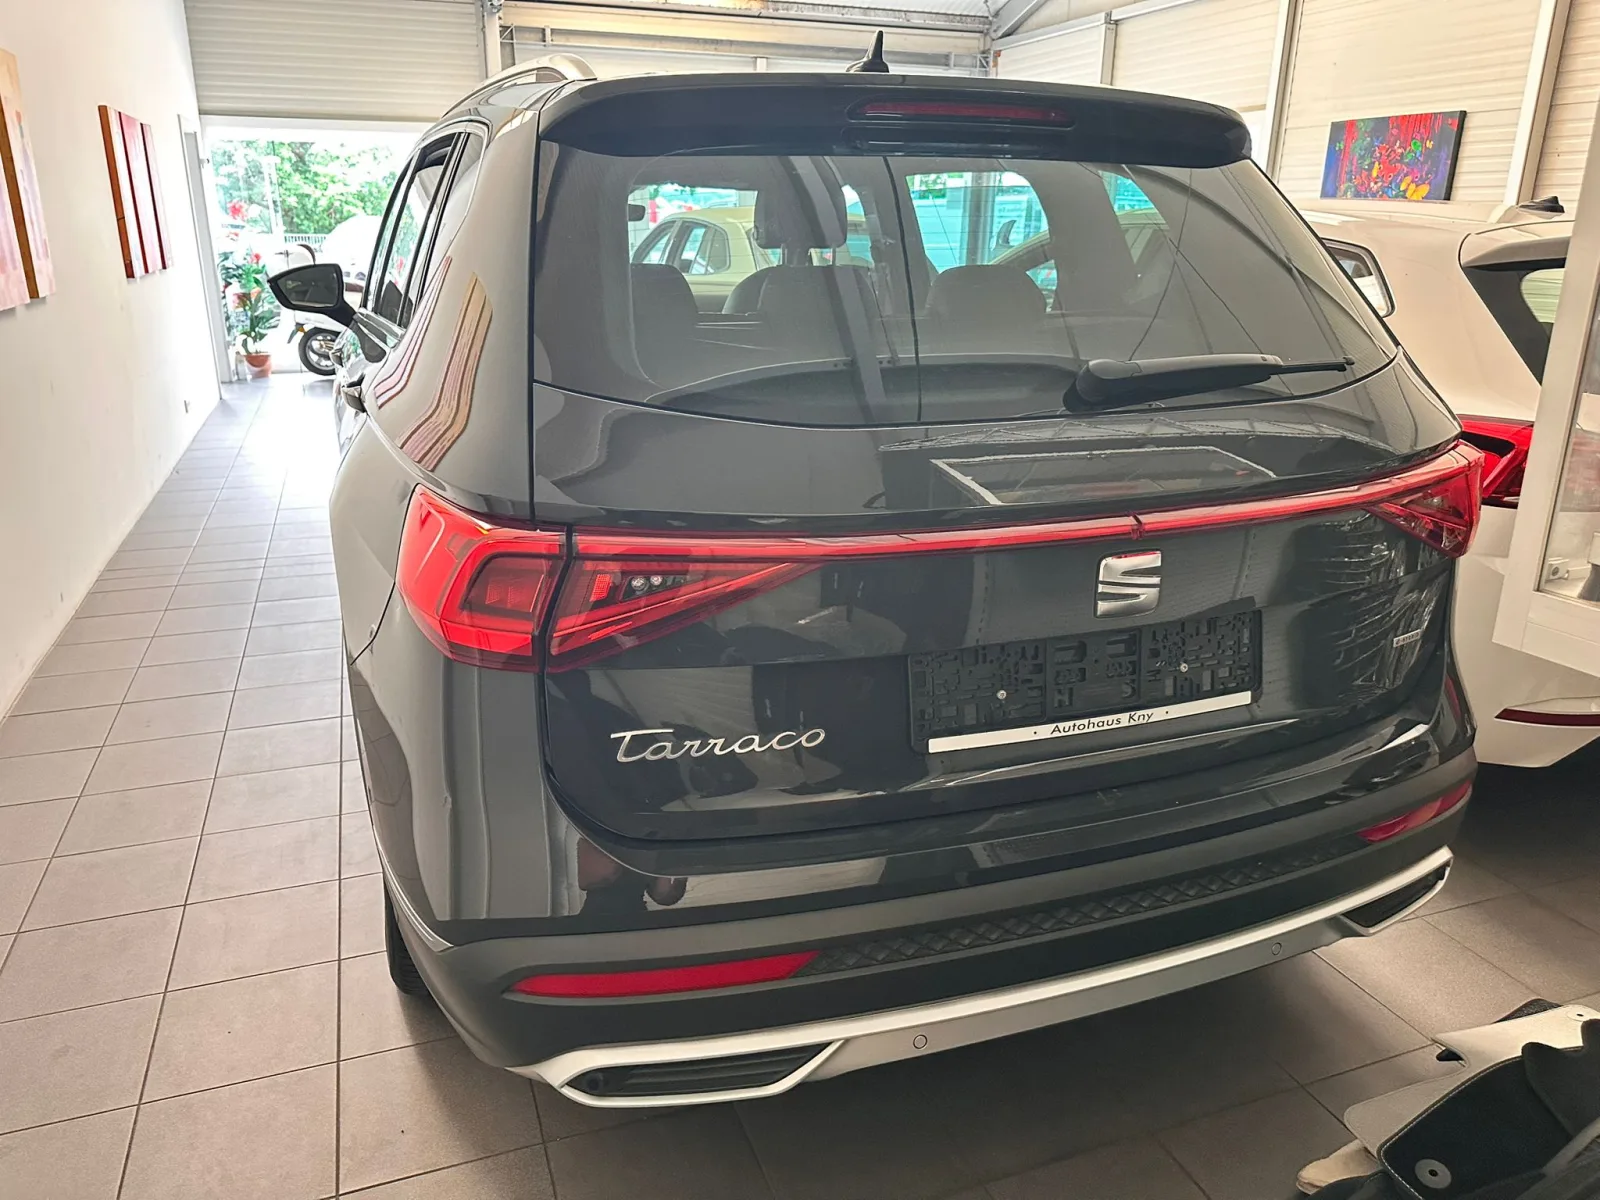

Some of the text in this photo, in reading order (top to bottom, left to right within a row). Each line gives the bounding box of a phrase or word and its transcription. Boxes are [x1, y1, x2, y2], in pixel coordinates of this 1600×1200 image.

[1050, 712, 1154, 735] Autohaus Kny
[610, 728, 826, 763] Tarraco
